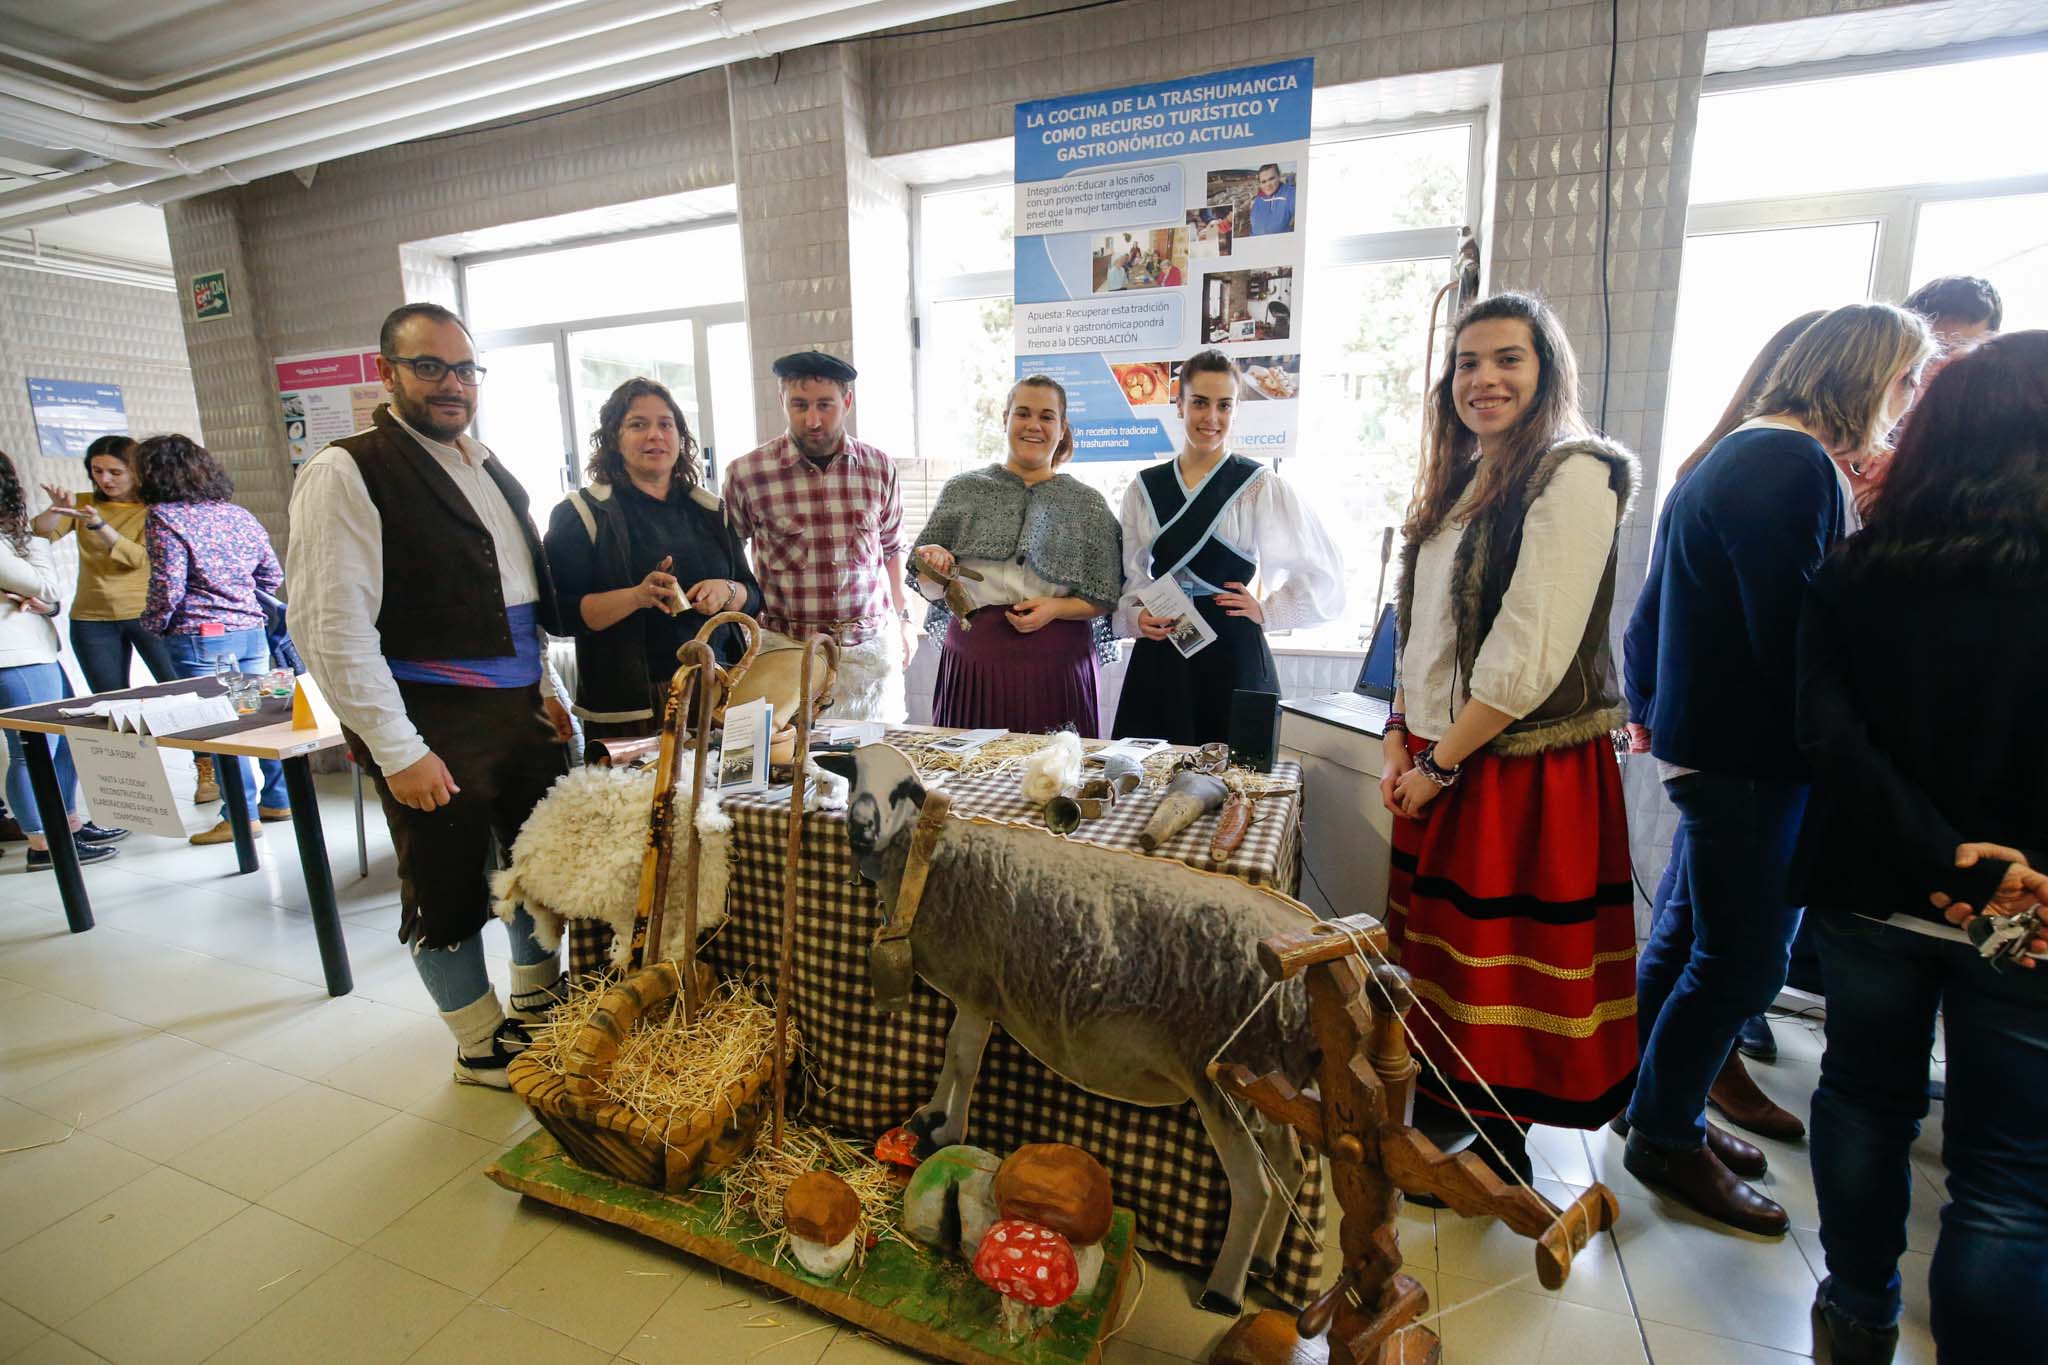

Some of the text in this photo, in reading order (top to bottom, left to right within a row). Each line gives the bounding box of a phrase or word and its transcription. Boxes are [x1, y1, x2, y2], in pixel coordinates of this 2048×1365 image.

[1026, 75, 1298, 128] LA COCINA DE LA TRASHUMANCIA
[1042, 98, 1279, 145] COMO RECURSO TURÍSTICO Y
[1056, 123, 1254, 162] GASTRONÓMICO ACTUAL
[1109, 179, 1115, 187] a
[1116, 176, 1129, 186] los
[1131, 173, 1155, 184] niños
[1026, 183, 1171, 208] con un proyecto intergeneracional
[1026, 196, 1157, 220] en el que la mujer también está
[1026, 218, 1064, 231] presente
[1027, 301, 1170, 322] Apuesta: Recuperar esta tradición
[1027, 316, 1164, 335] culinaria y gastronómica pondrá
[1027, 332, 1138, 350] freno a la DESPOBLACIÓN
[1085, 426, 1118, 437] recetario
[1119, 424, 1158, 436] tradicional
[1080, 438, 1129, 449] trashumancia
